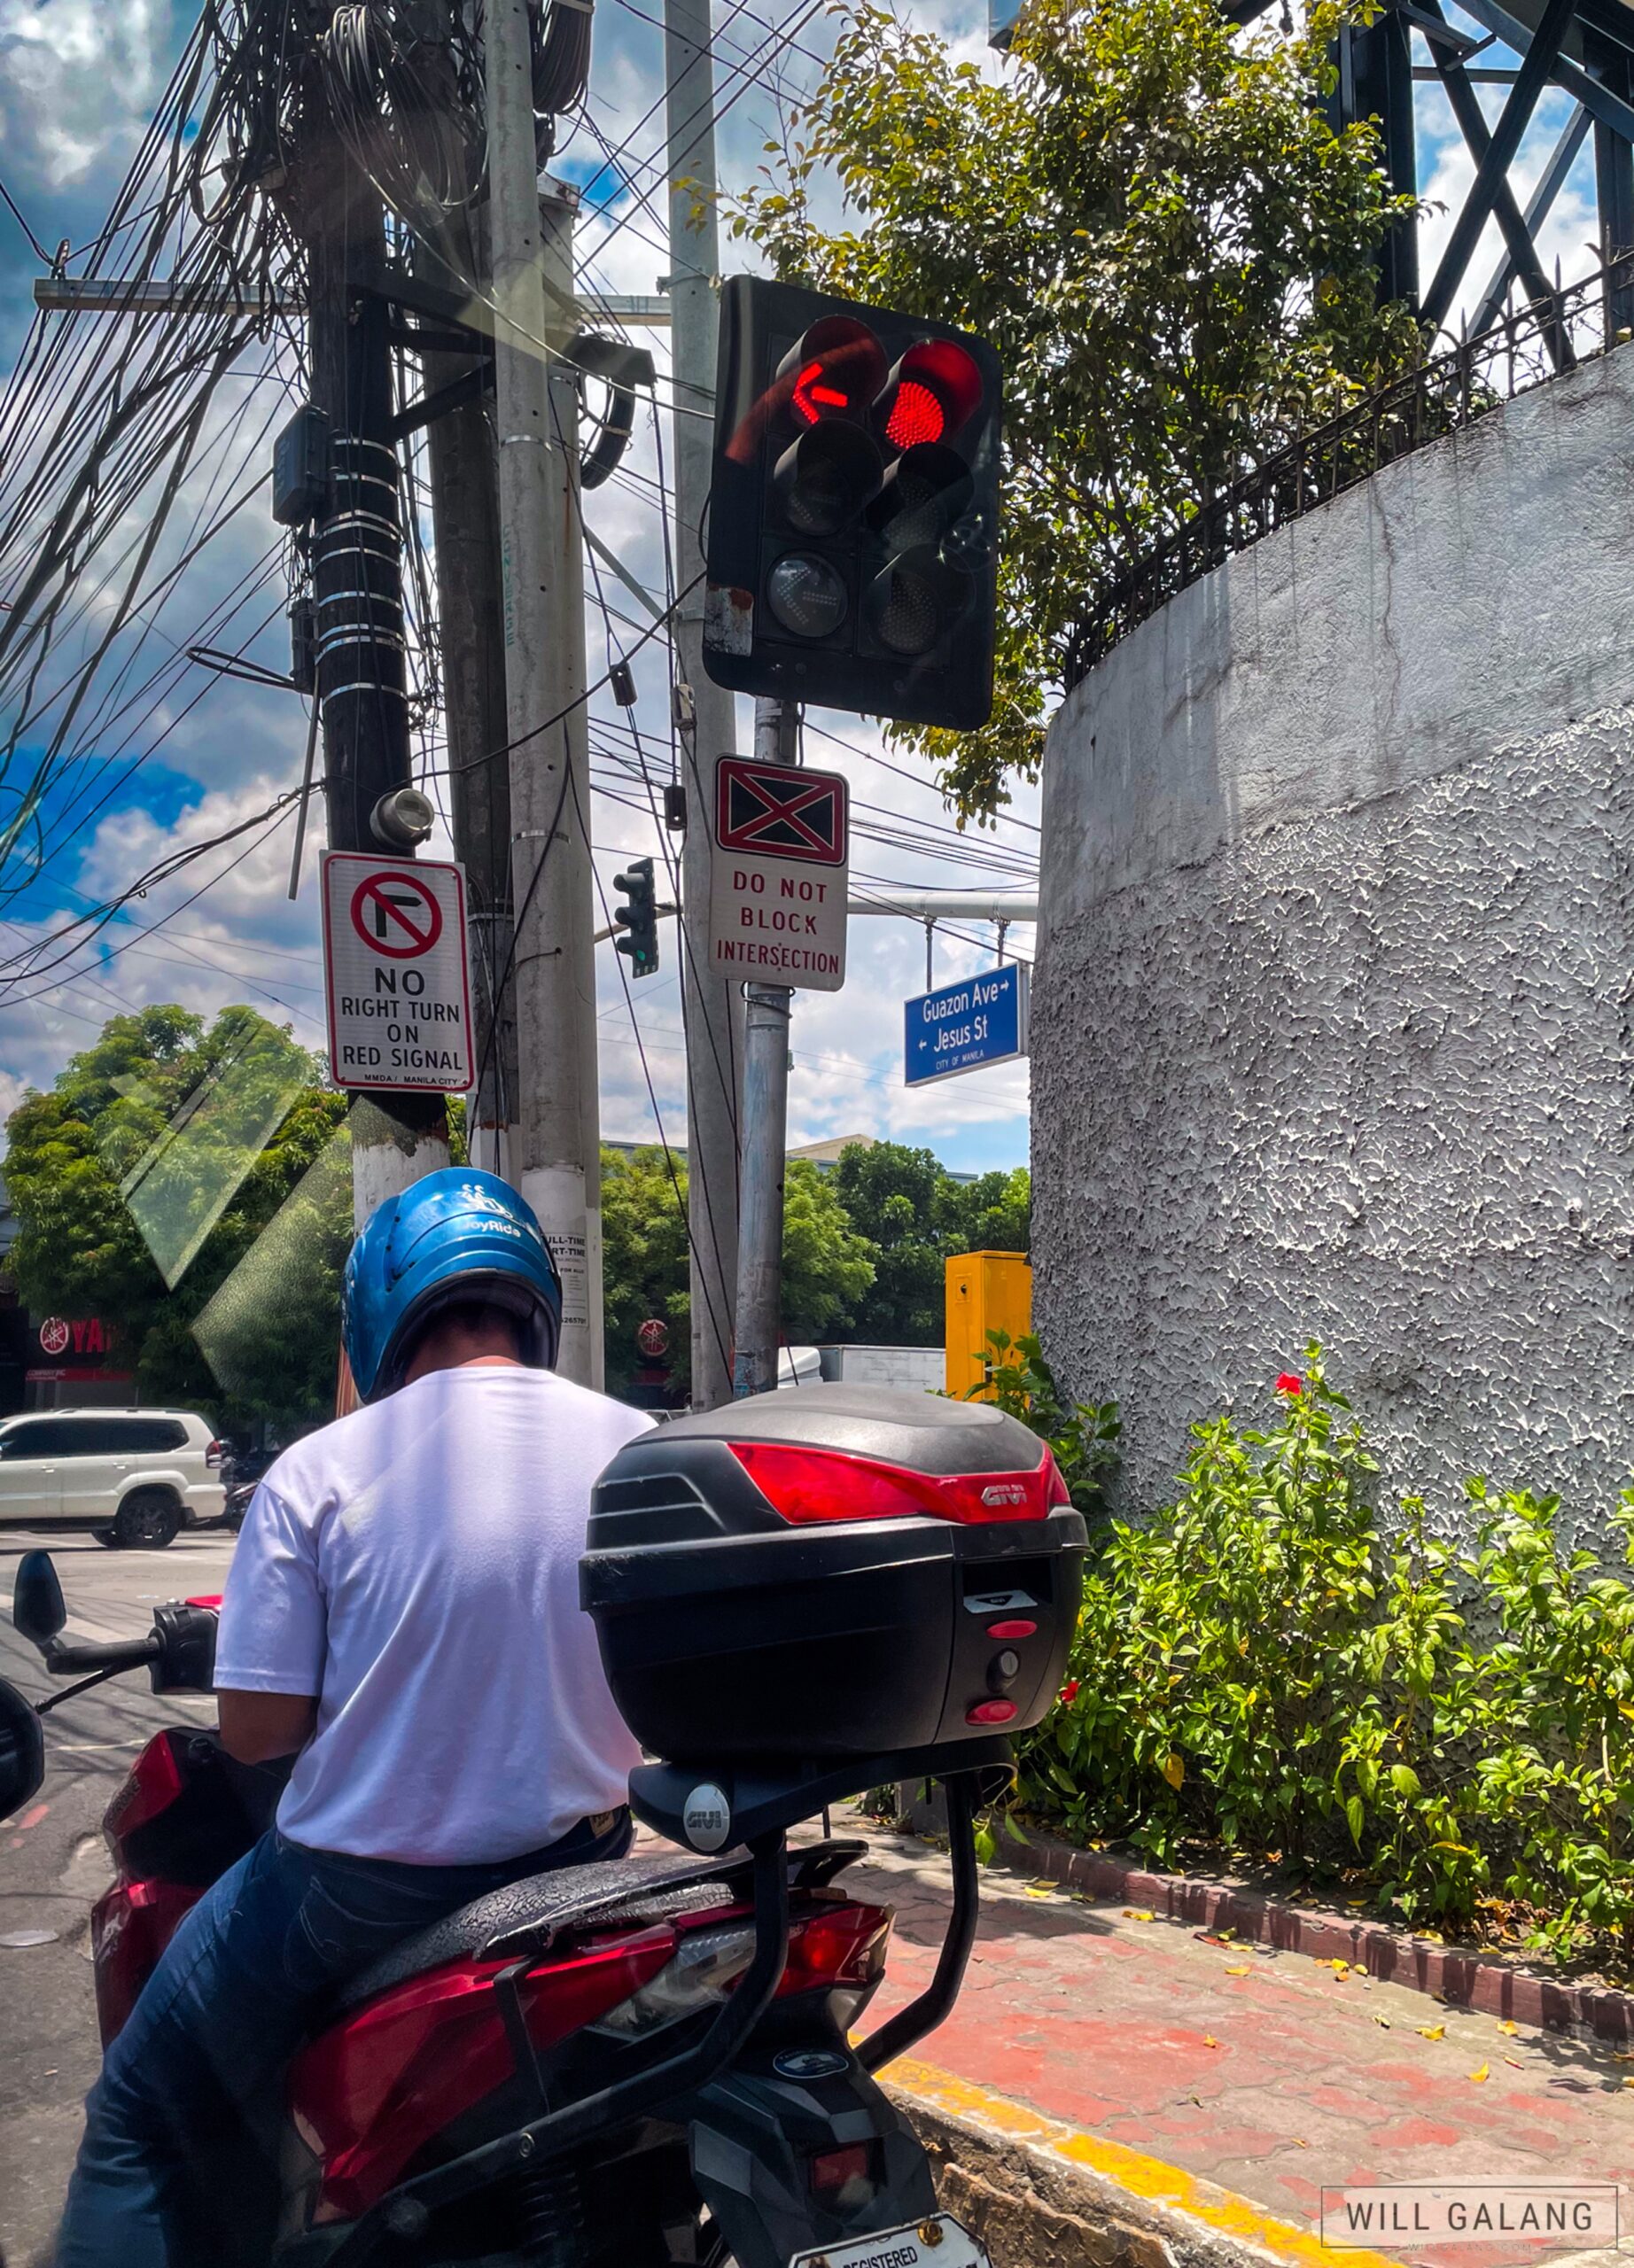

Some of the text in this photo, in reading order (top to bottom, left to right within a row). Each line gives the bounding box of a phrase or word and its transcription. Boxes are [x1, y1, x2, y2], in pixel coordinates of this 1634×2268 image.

[734, 871, 827, 903] DO NOT
[741, 907, 817, 935] BLOCK
[717, 939, 839, 975] INTERSECTION
[375, 967, 424, 996] NO
[341, 997, 459, 1023] RIGHT TURN
[922, 983, 999, 1022] Guazon Ave
[387, 1024, 418, 1044] ON
[933, 1014, 988, 1052] Jesus St
[343, 1045, 463, 1070] RED SIGNAL
[936, 1049, 984, 1070] CITY OF MANILA
[403, 1076, 436, 1085] MANILA
[439, 1077, 458, 1086] CITY
[981, 1485, 1027, 1505] GIVI
[686, 1811, 722, 1829] GIVI
